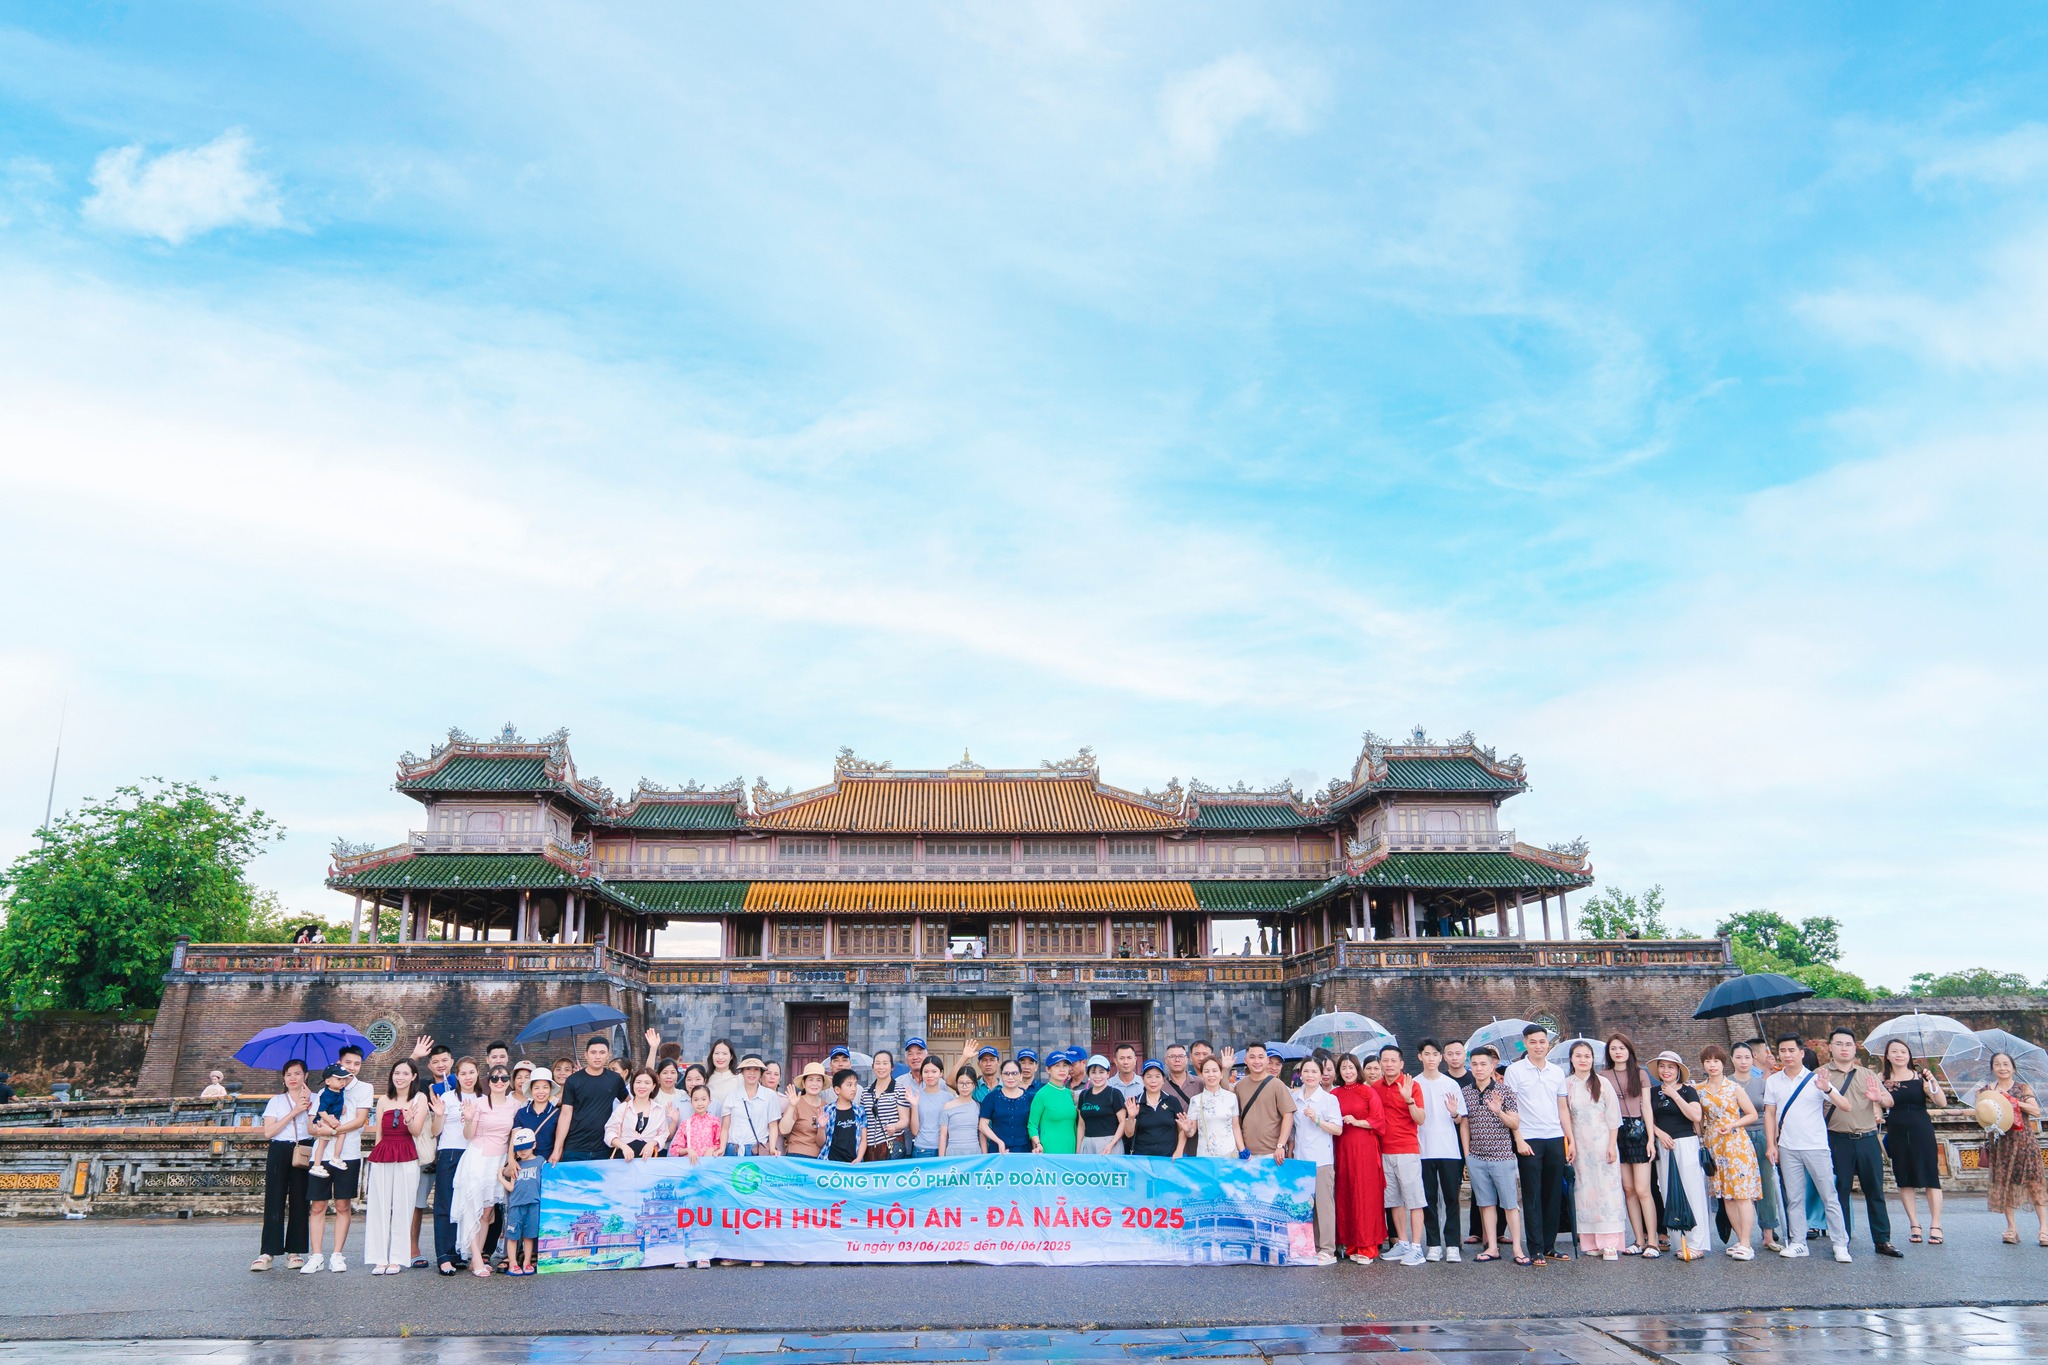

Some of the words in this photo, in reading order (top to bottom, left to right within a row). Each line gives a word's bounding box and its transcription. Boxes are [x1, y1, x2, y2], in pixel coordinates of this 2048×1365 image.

[764, 1174, 809, 1183] GOOVET
[816, 1172, 868, 1188] CÔNG
[872, 1175, 891, 1188] TY
[895, 1167, 921, 1188] CỔ
[926, 1167, 970, 1187] PHẦN
[974, 1169, 1005, 1189] TẬP
[1009, 1168, 1057, 1186] ĐOÀN
[1061, 1172, 1128, 1186] GOOVET
[677, 1206, 713, 1229] DU
[721, 1208, 782, 1235] LỊCH
[792, 1199, 847, 1229] HUẾ
[866, 1202, 914, 1235] HỘI
[924, 1207, 962, 1228] AN
[986, 1199, 1025, 1228] ĐÀ
[1033, 1195, 1113, 1229] NẴNG
[1121, 1206, 1185, 1229] 2025
[847, 1240, 861, 1252] Từ
[863, 1240, 895, 1254] ngày
[897, 1240, 970, 1253] 03/06/2025
[973, 1239, 997, 1251] đến
[1000, 1240, 1071, 1253] 06/06/2025
